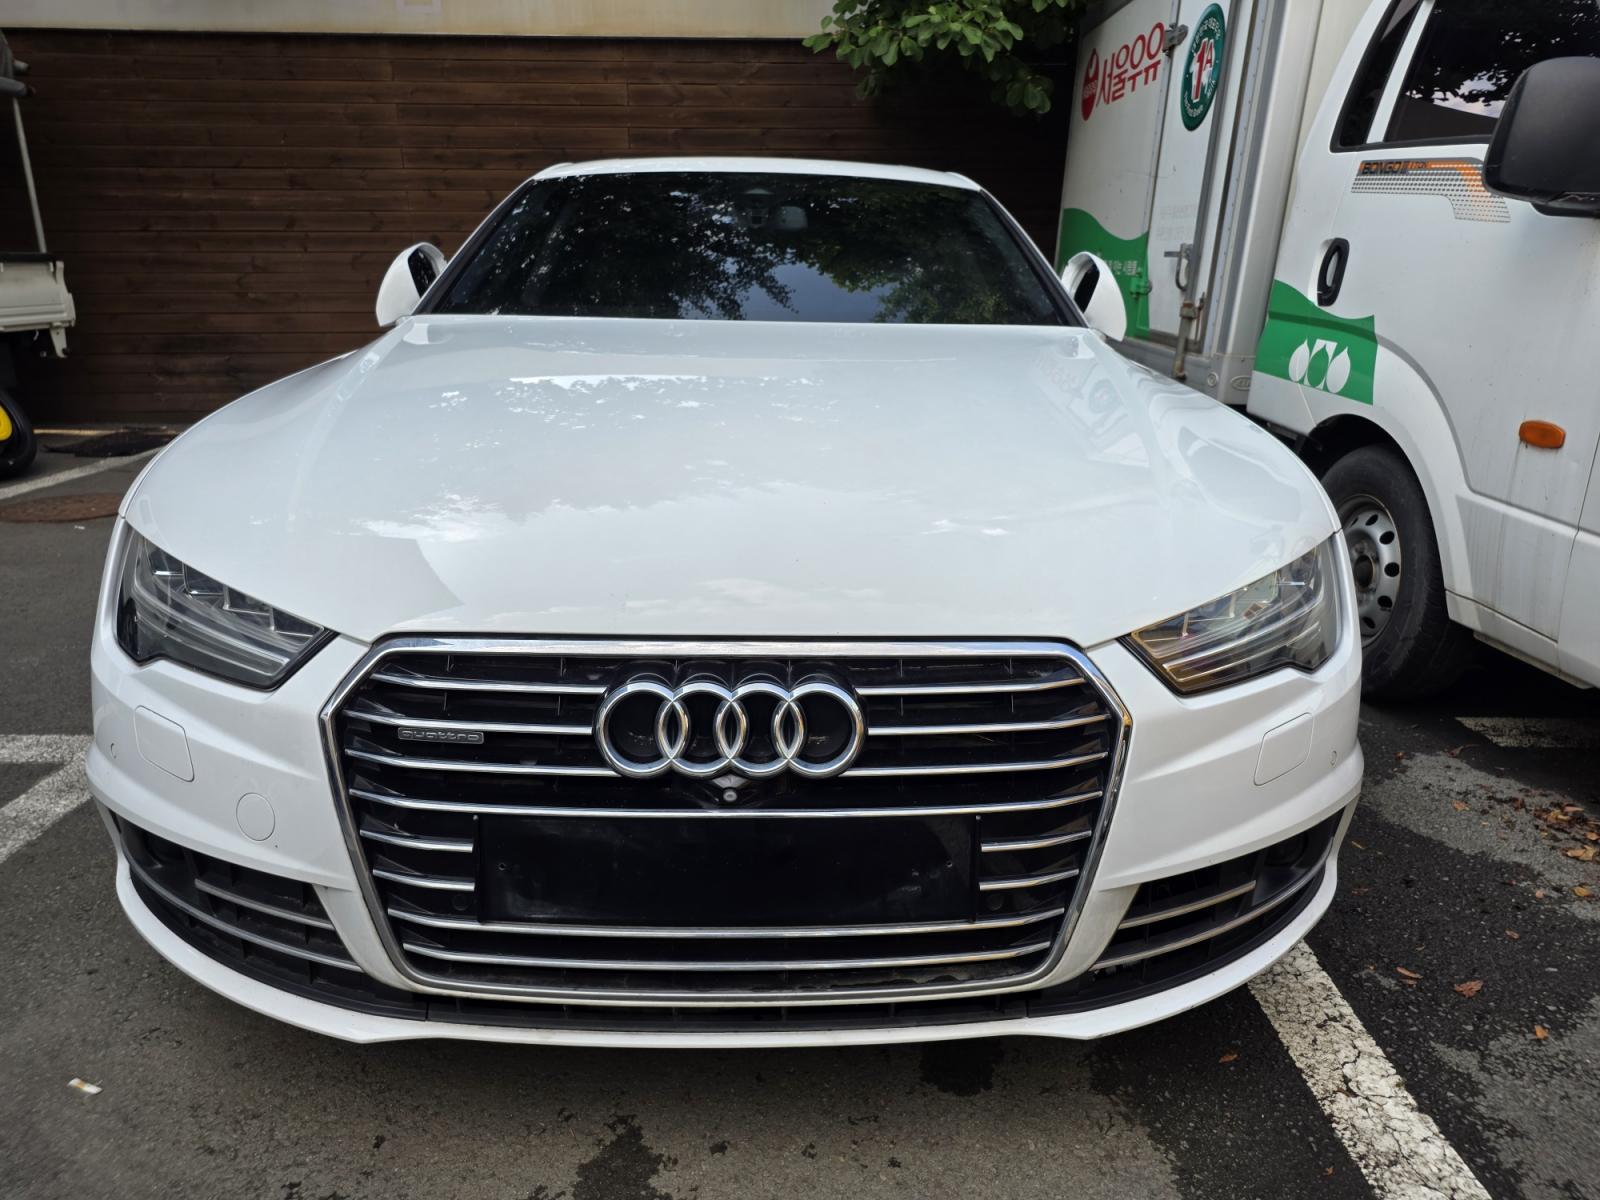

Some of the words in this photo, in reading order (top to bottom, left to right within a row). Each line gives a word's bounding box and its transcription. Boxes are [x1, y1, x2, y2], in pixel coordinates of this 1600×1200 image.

[1096, 22, 1164, 107] 서울우유
[1361, 161, 1402, 175] BONGO
[400, 729, 480, 741] quattro
